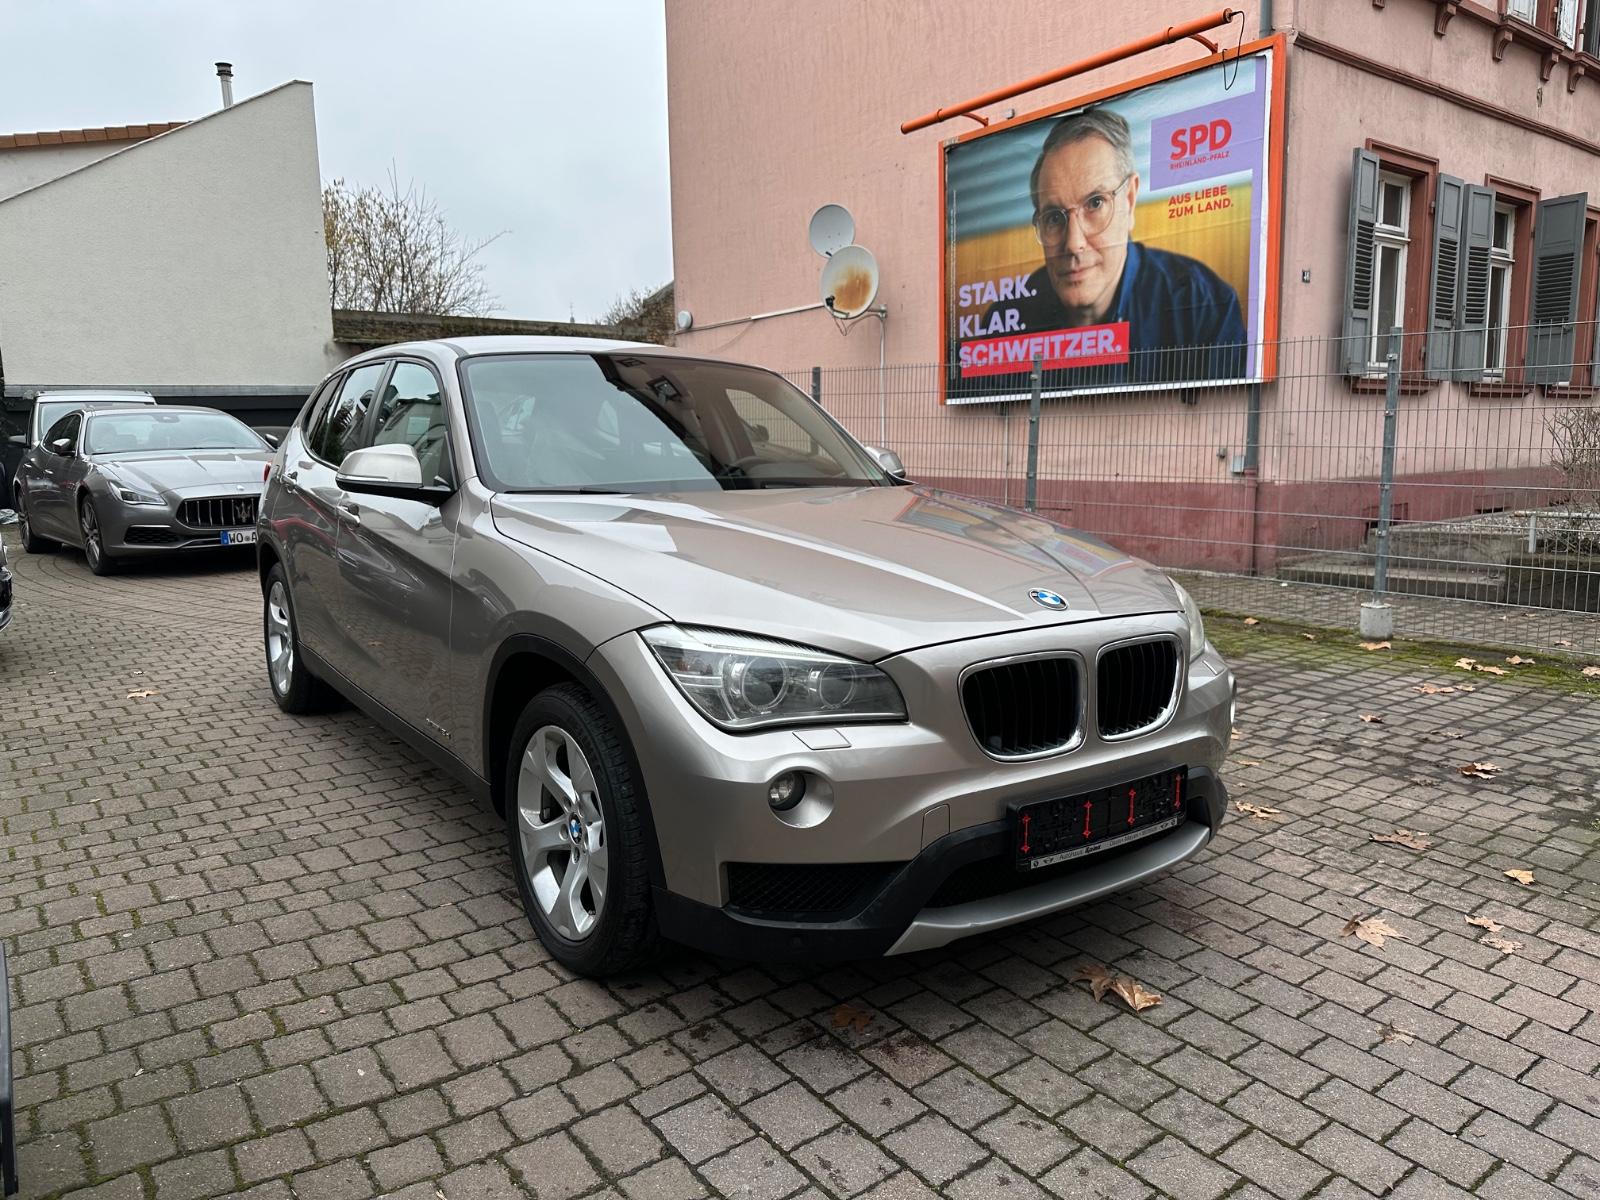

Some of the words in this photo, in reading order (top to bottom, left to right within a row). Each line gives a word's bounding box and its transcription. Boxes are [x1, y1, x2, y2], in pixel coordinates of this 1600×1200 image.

[1170, 119, 1232, 160] SPD
[1169, 151, 1230, 169] RHEINLAND-PFALZ
[1168, 192, 1191, 207] AUS
[1195, 185, 1227, 200] LIEBE
[1168, 205, 1193, 219] ZUM
[1198, 198, 1234, 213] LAND.
[958, 274, 1037, 307] STARK.
[958, 308, 1026, 338] KLAR.
[958, 329, 1122, 368] SCHWEITZER.
